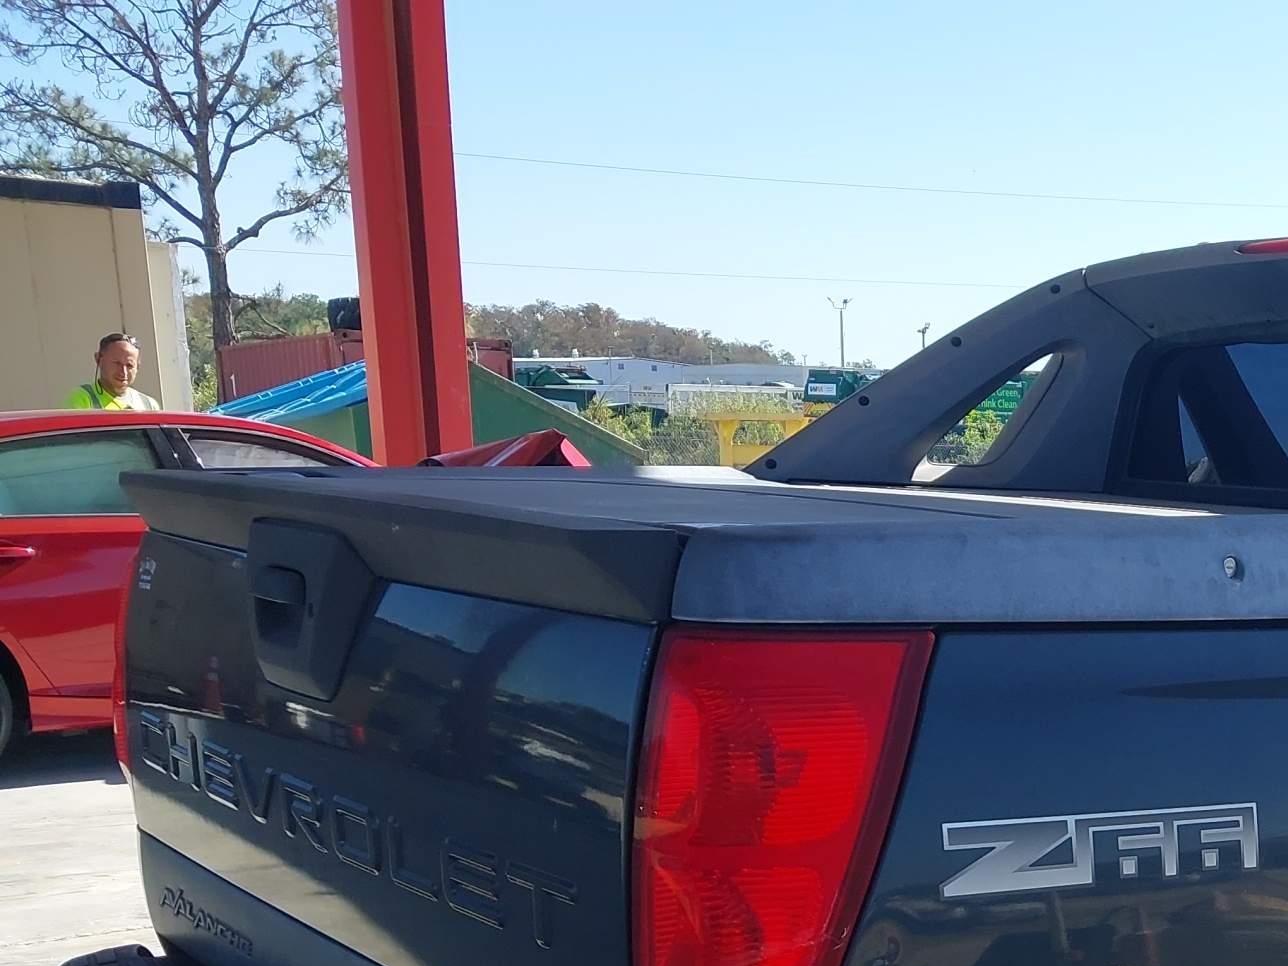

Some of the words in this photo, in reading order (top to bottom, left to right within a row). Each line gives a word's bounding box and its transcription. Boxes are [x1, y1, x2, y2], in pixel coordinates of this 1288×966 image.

[997, 398, 1017, 408] Clean
[140, 709, 578, 950] CHEVROLET
[159, 887, 253, 957] AVALANCHE
